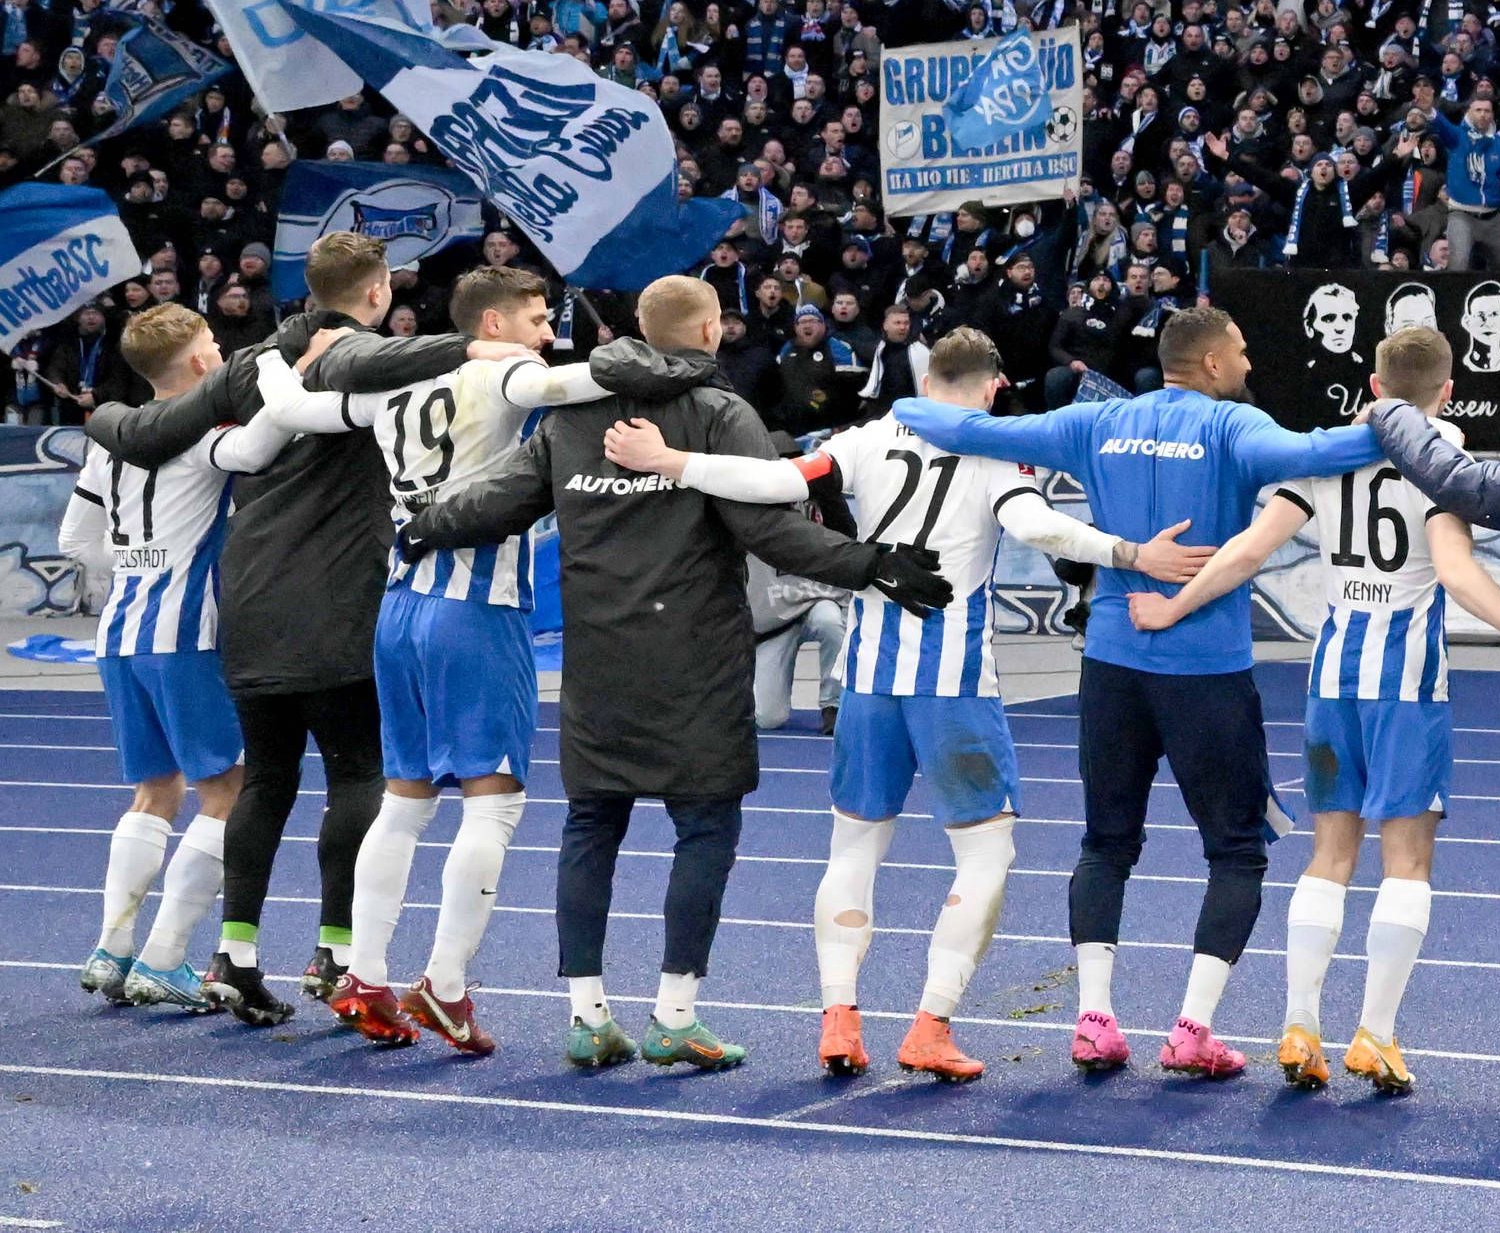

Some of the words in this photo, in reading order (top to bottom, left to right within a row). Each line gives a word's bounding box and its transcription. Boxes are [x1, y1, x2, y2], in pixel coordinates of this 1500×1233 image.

[889, 172, 912, 190] HA
[917, 169, 941, 186] HO
[946, 167, 970, 184] HE
[982, 162, 1044, 183] HERTHA
[386, 386, 457, 492] 19
[1098, 437, 1206, 461] AUTOHERO
[864, 449, 961, 556] 21
[1330, 467, 1411, 573] 16
[1343, 578, 1392, 604] KENNY
